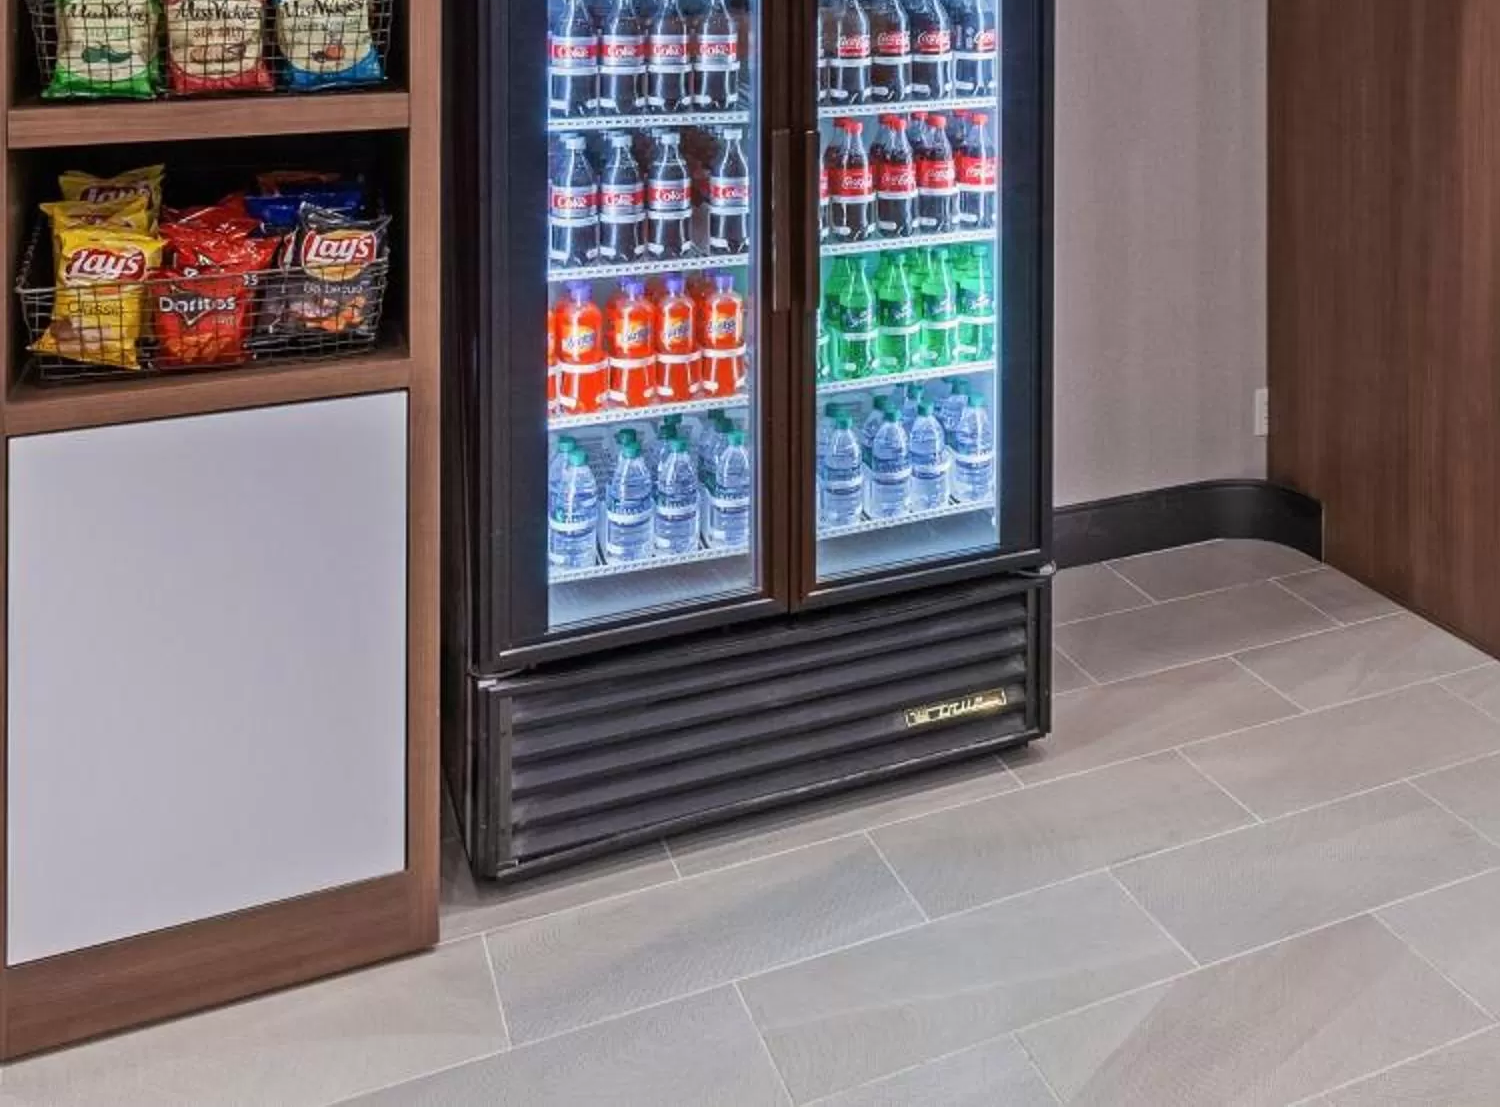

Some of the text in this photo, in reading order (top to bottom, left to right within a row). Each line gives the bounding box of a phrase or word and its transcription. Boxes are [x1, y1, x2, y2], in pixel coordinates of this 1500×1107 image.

[305, 234, 373, 264] Lay's
[69, 248, 143, 281] Lay's
[159, 296, 237, 313] Doritos
